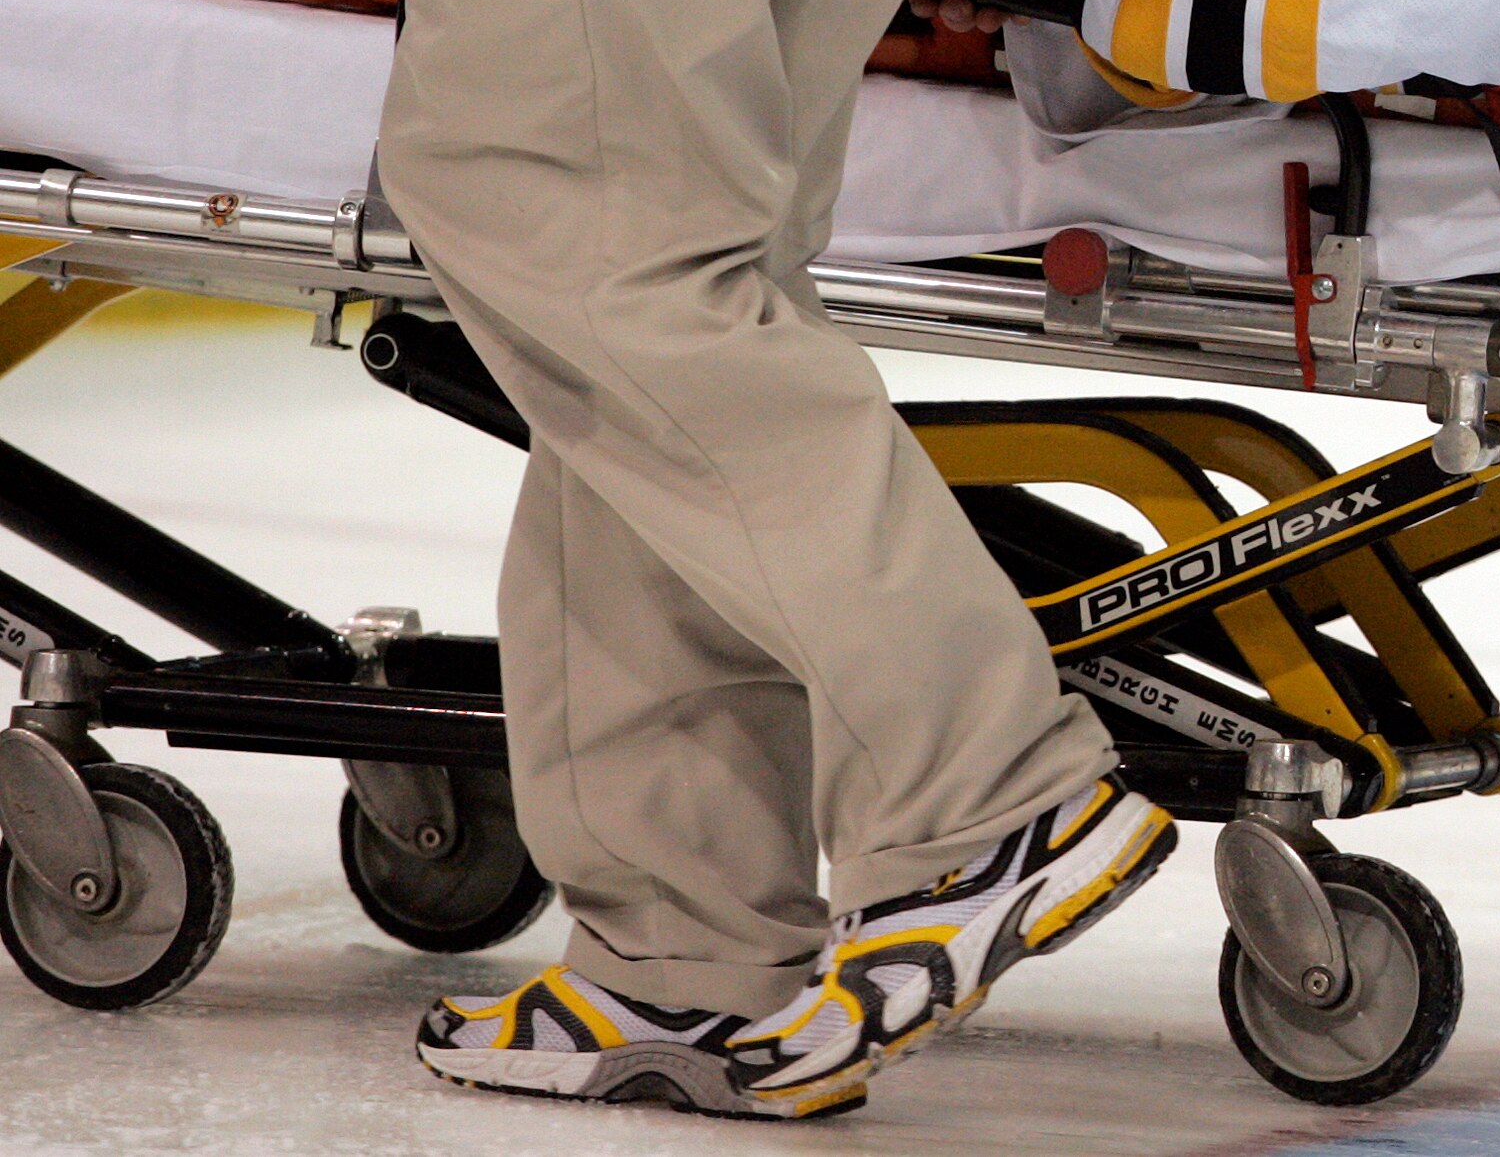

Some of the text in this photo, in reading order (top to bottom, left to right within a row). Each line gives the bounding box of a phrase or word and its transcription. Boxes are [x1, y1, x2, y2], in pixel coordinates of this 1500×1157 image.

[1088, 549, 1215, 626] PRO
[1230, 483, 1382, 567] Flexx
[1070, 658, 1256, 748] BURGH EMS
